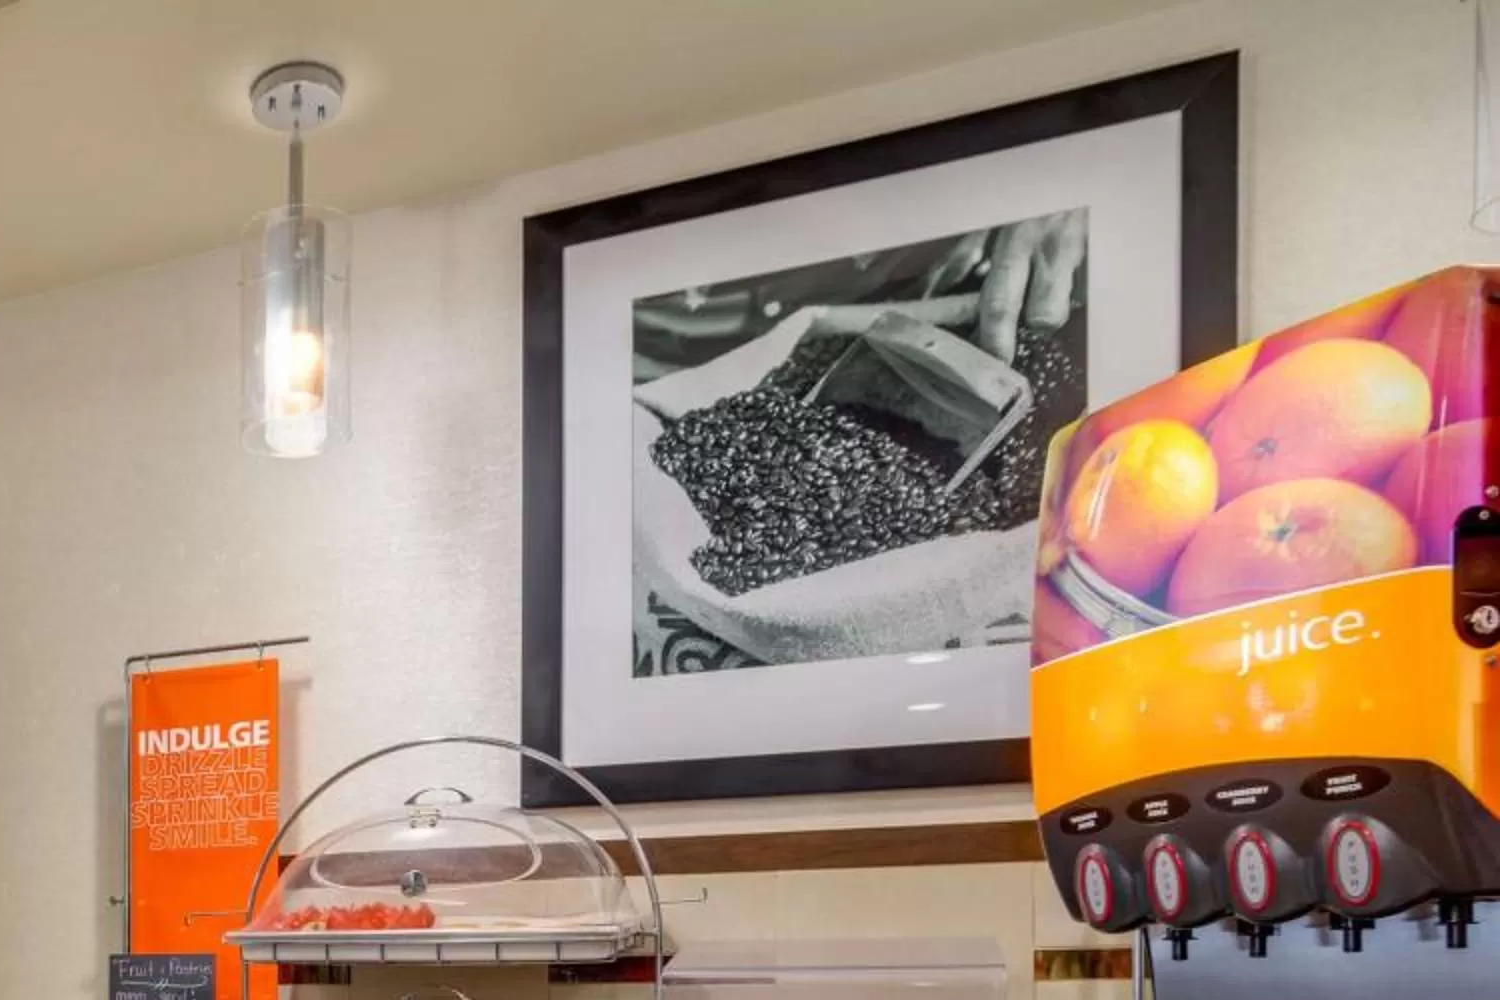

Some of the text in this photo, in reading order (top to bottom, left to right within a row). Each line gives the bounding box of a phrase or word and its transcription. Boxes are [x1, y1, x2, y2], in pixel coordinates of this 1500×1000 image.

[1236, 609, 1381, 677] juice.
[137, 719, 271, 757] INDULGE
[141, 748, 268, 779] DRIZZLE
[140, 769, 268, 801] SPREAD
[131, 791, 279, 829] SPRINKLE
[149, 819, 260, 851] SMILE.
